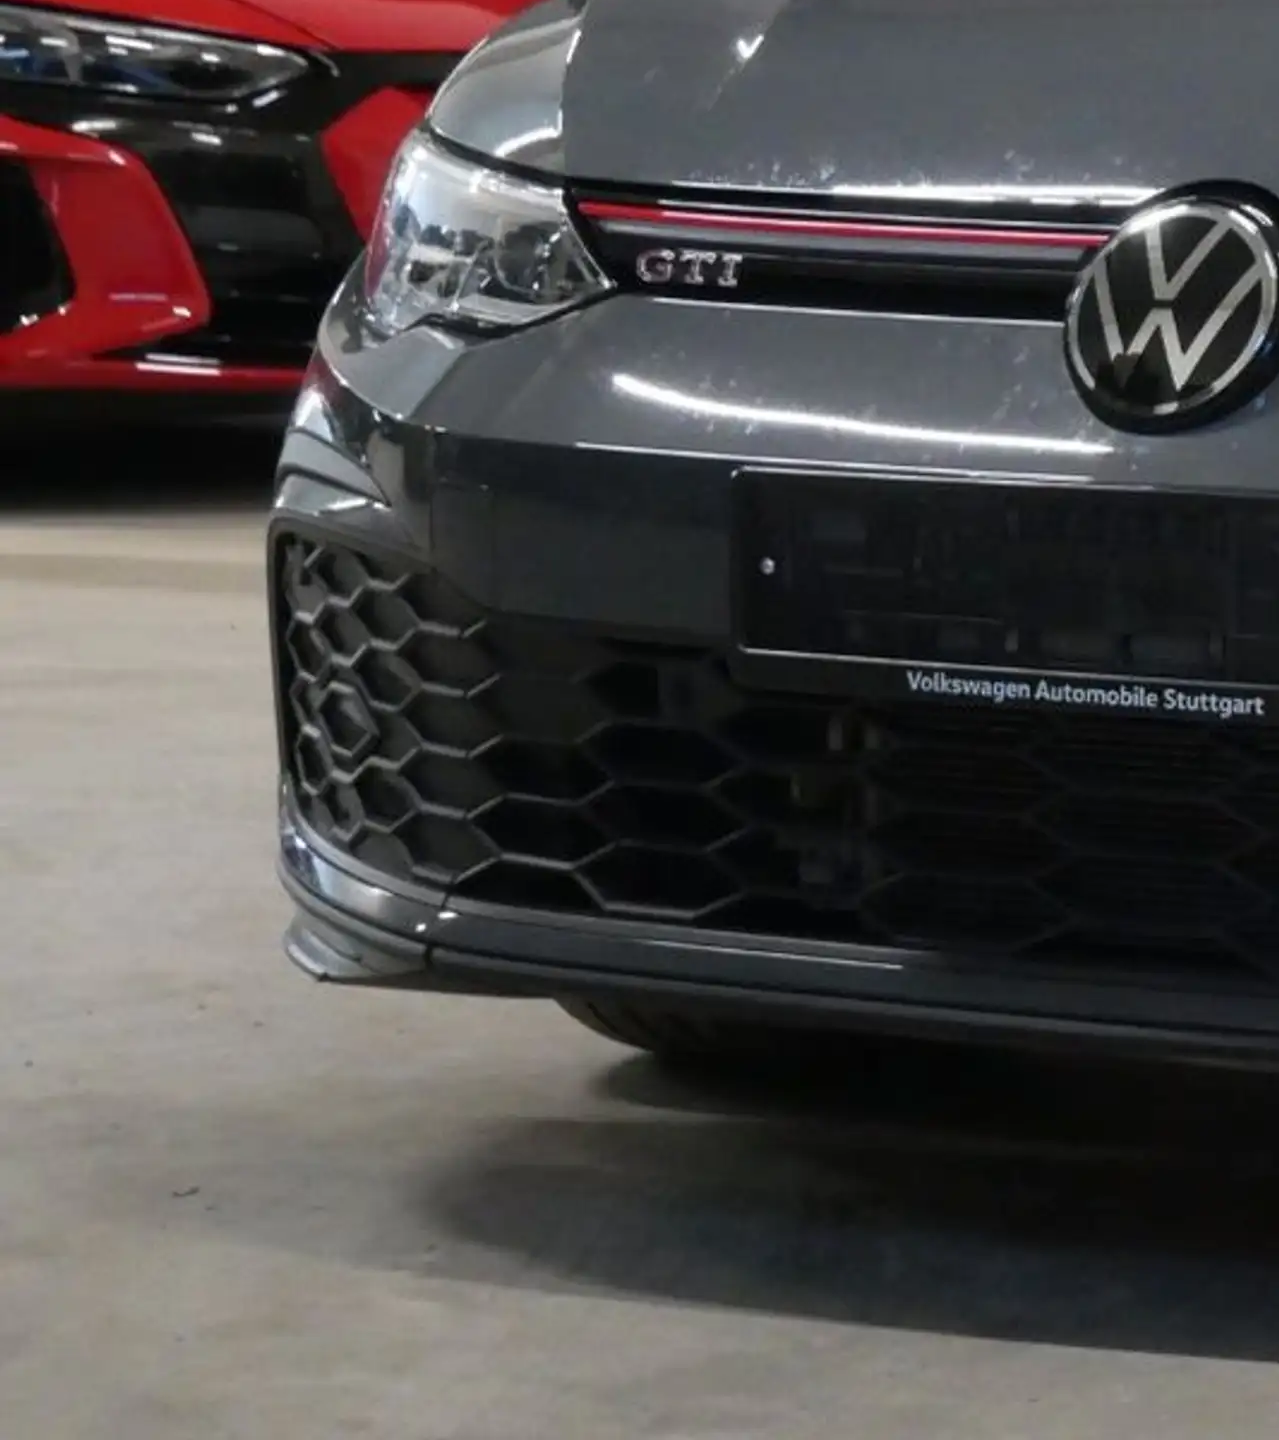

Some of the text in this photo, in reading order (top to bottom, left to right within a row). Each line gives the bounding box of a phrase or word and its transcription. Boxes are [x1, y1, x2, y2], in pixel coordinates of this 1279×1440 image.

[636, 247, 743, 287] GTI
[906, 669, 1031, 703] Volkswagen
[1034, 679, 1159, 708] Automobile
[1162, 688, 1266, 720] Stuttgart
